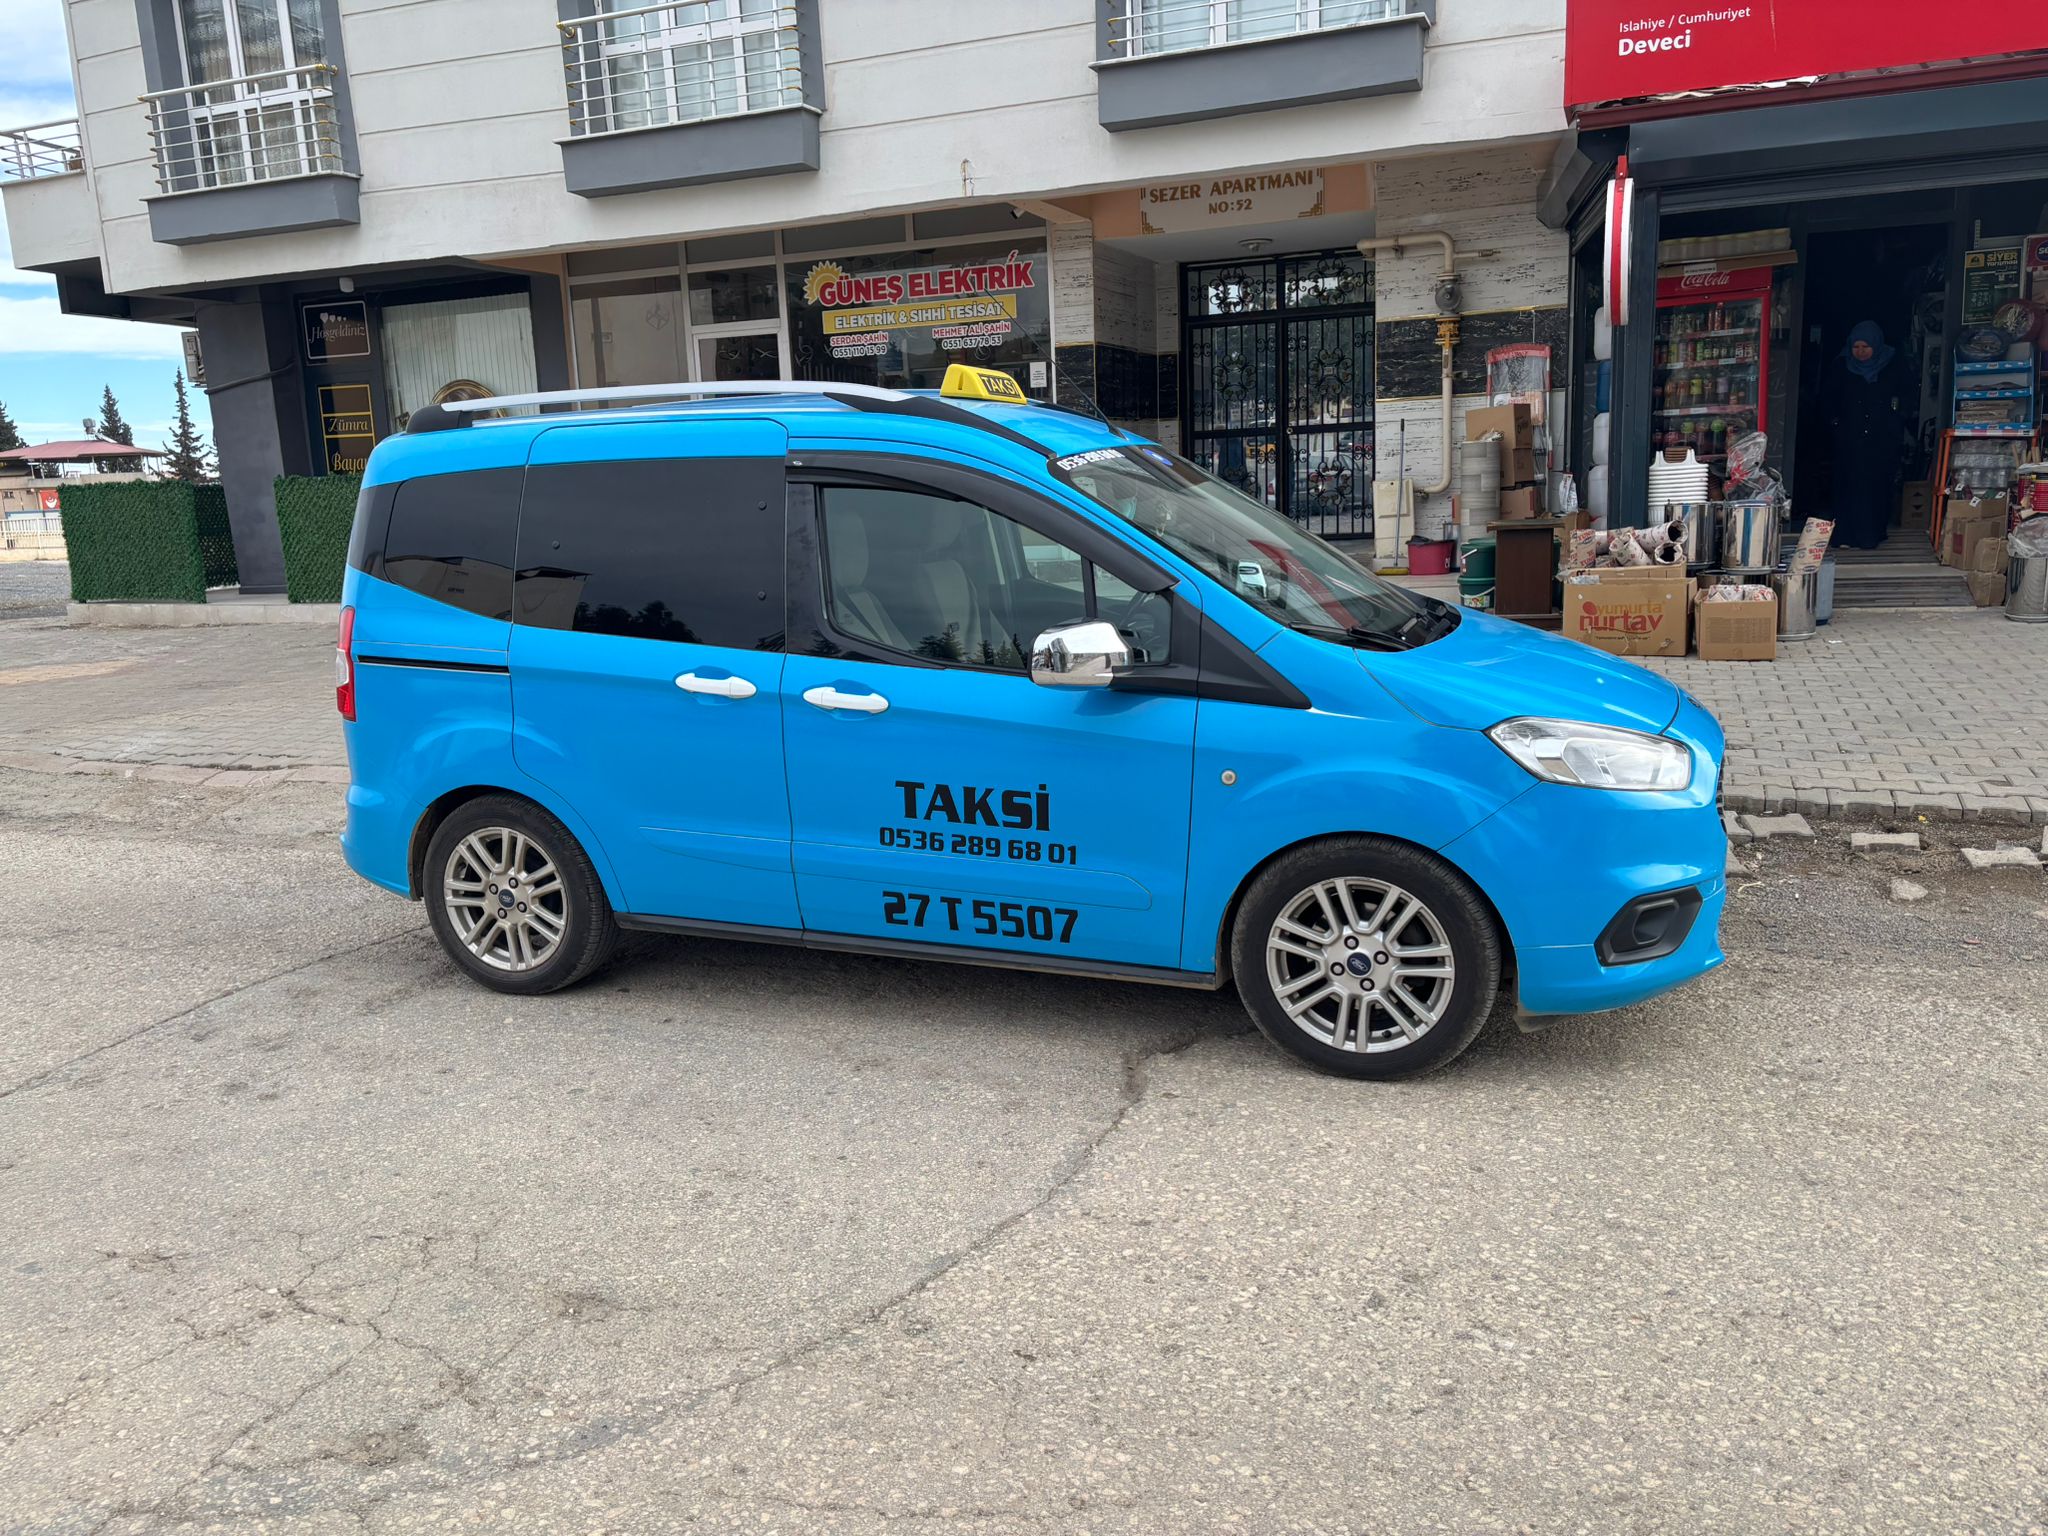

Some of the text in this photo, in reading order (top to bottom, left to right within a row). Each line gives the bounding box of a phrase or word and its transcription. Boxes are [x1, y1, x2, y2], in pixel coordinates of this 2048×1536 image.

[1619, 7, 1751, 32] Islahiye / Cumhuriyet
[1618, 29, 1691, 56] Deveci
[1150, 170, 1313, 203] SEZER APARTMANI
[1208, 199, 1253, 215] NO:52
[819, 250, 1035, 306] GÜNEŞ ELEKTRİK
[834, 301, 1004, 329] ELEKTRİK & SIHHİ TESİSAT
[309, 323, 367, 343] Hoşgeldiniz
[831, 331, 888, 345] SERDAR ŞAHİN
[933, 321, 1011, 337] MEHMET ALİ ŞAHİN
[833, 345, 887, 358] 0551 110 15 99
[942, 335, 1002, 349] 0551 637 78 53
[328, 418, 369, 432] Zümra
[1596, 600, 1664, 615] yumurta
[879, 827, 1077, 865] 0536 289 68 01
[882, 890, 1079, 943] 27 T 5507
